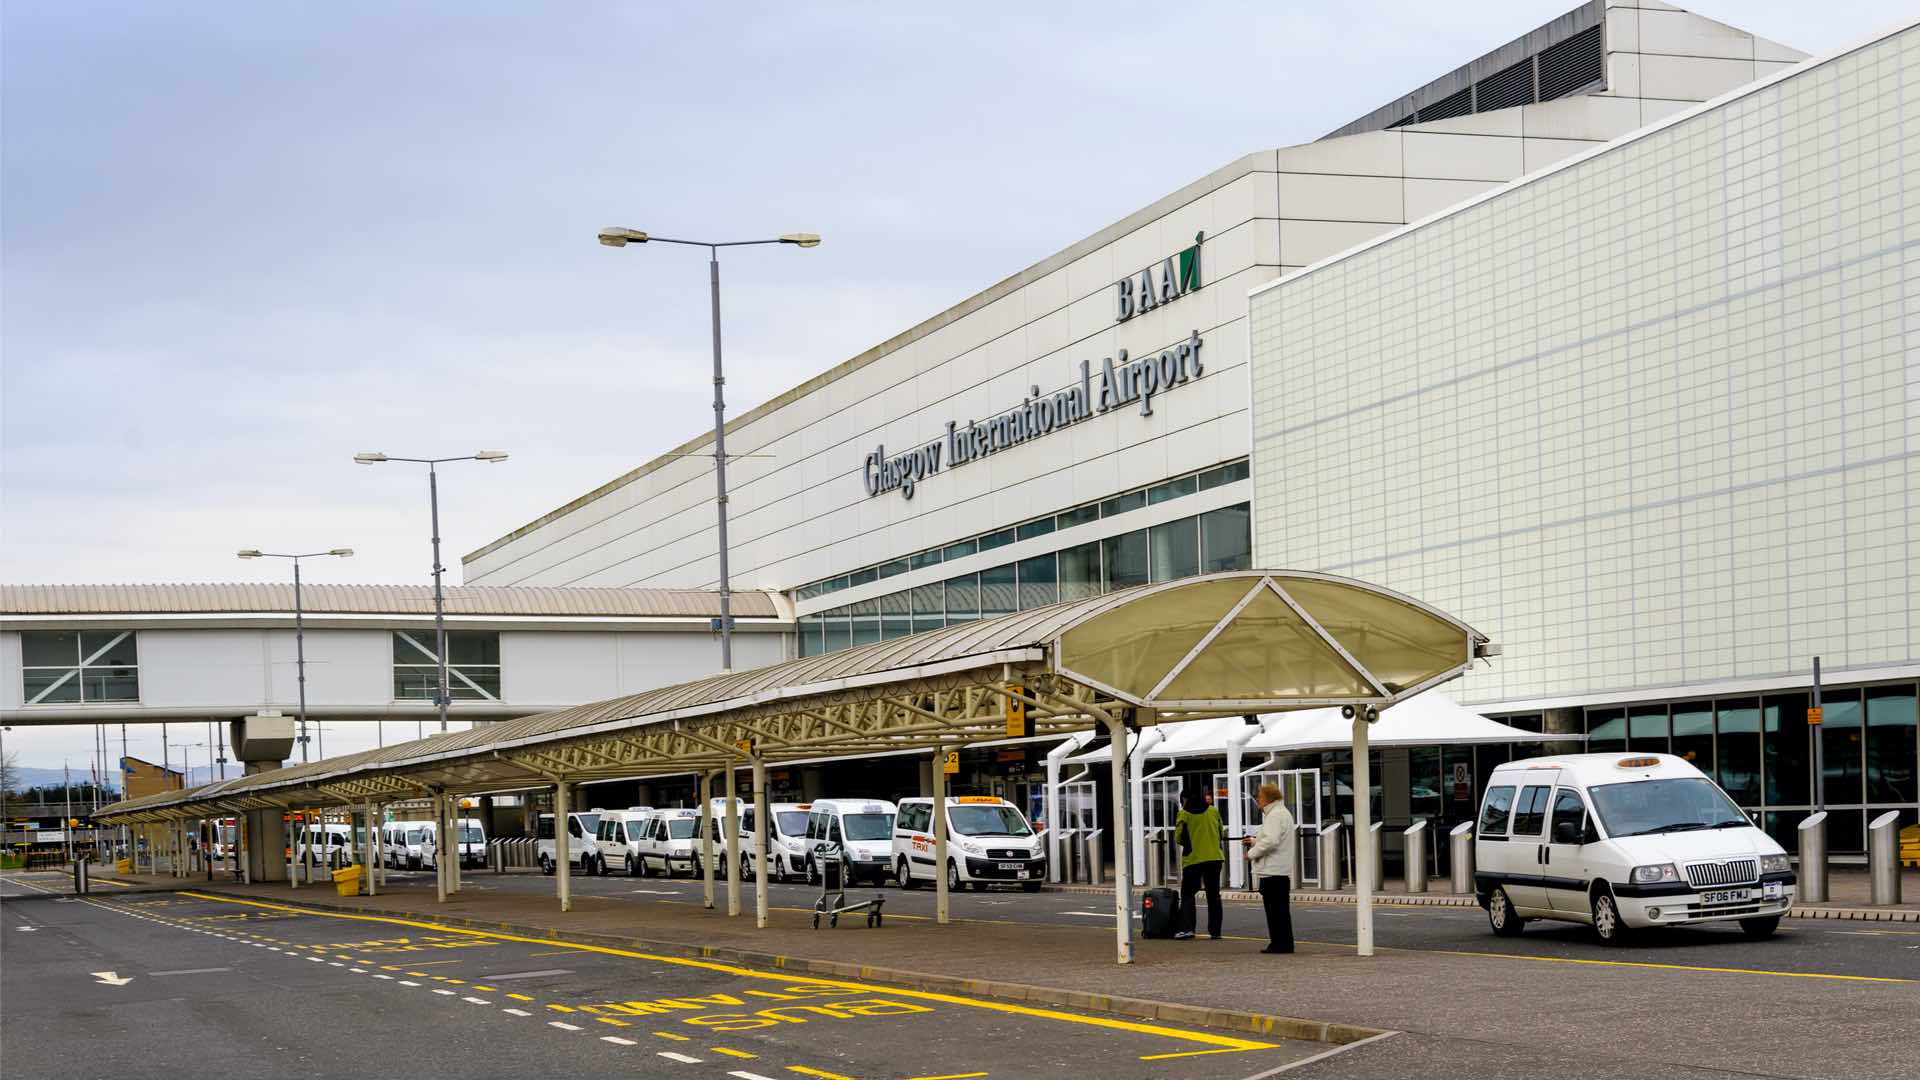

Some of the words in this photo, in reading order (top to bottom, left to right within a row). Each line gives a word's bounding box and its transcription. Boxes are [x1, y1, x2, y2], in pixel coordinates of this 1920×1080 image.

[1114, 257, 1180, 323] BAA
[863, 440, 942, 500] Glasgow
[945, 359, 1093, 467] International
[1096, 329, 1204, 417] Airport
[912, 842, 928, 852] TAXI
[1704, 891, 1729, 903] SF06
[682, 999, 935, 1032] BUS
